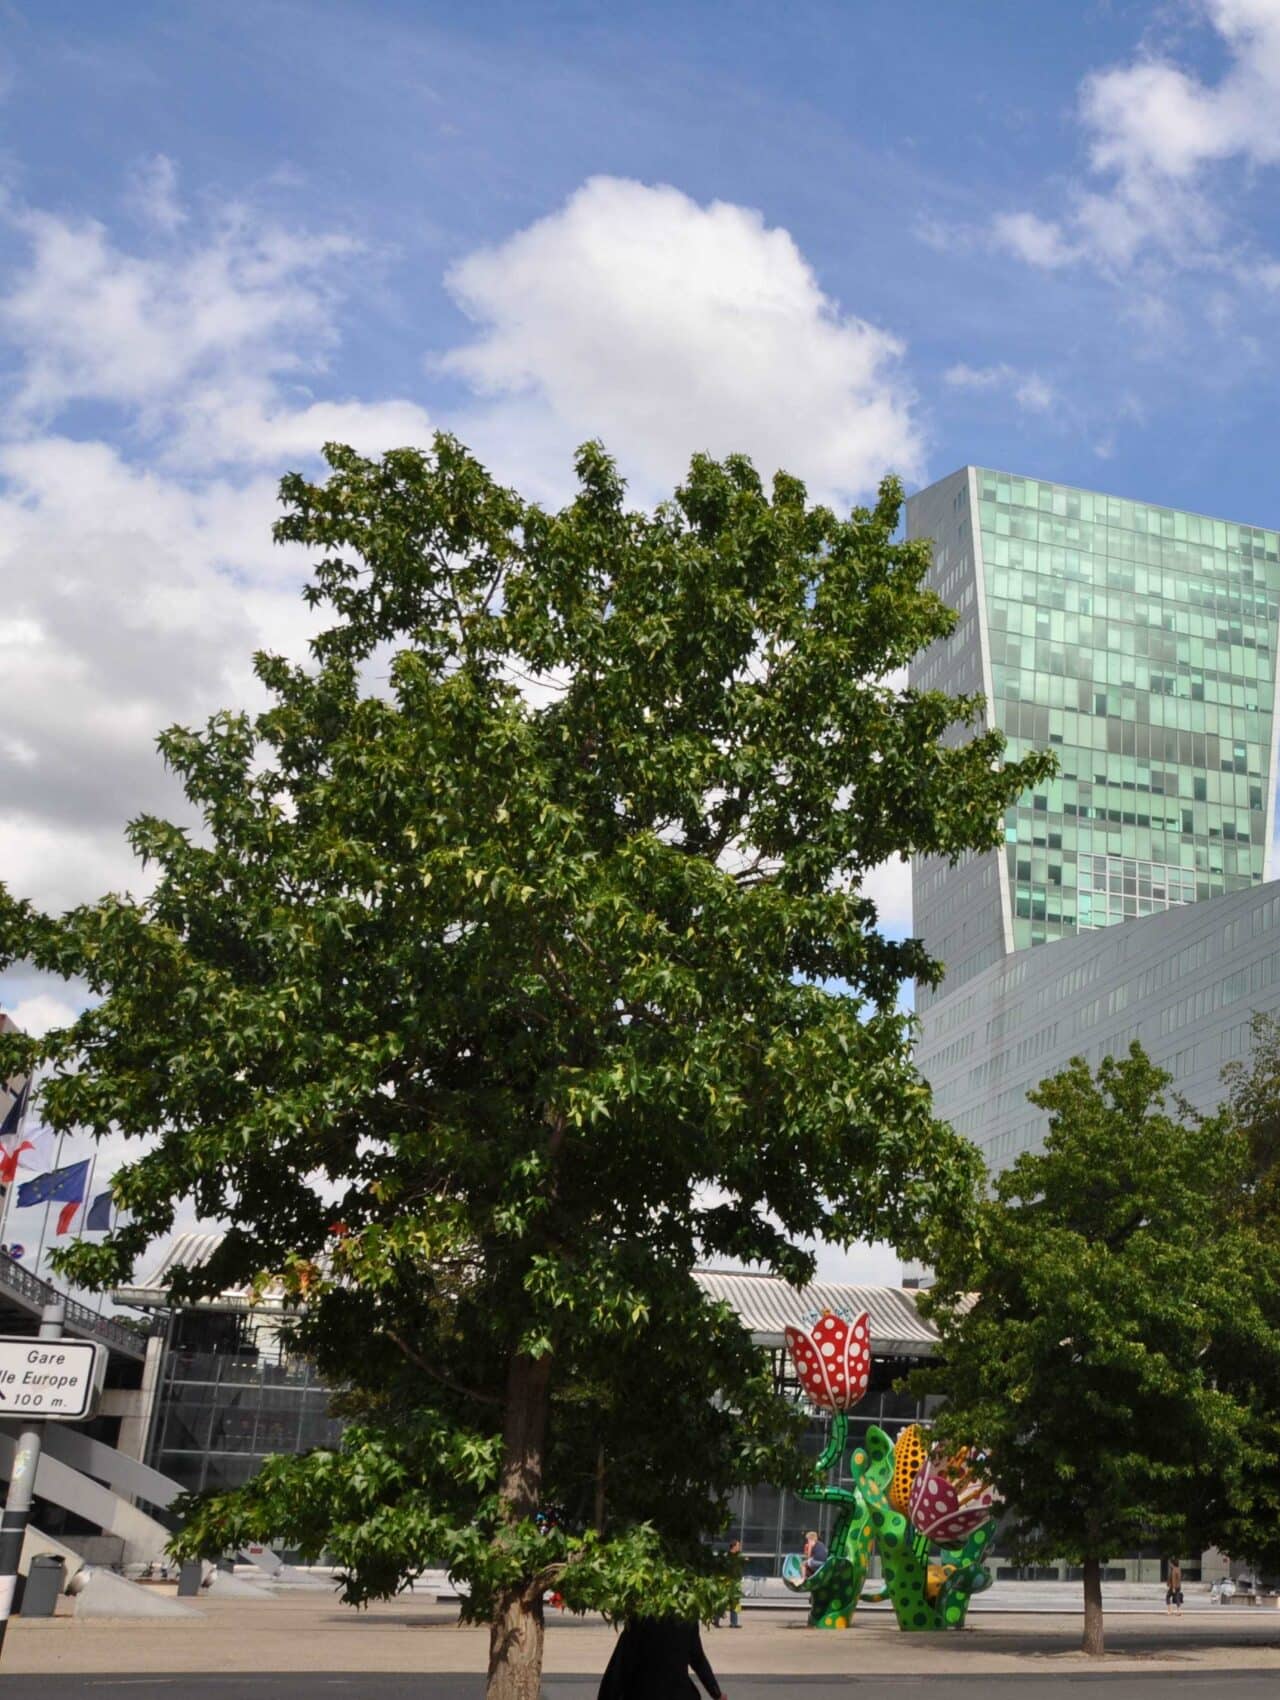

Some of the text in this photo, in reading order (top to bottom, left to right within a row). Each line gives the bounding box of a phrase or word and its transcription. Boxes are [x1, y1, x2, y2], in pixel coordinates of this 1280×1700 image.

[27, 1350, 65, 1365] Gare
[22, 1371, 78, 1389] Europe
[14, 1393, 43, 1406] 100
